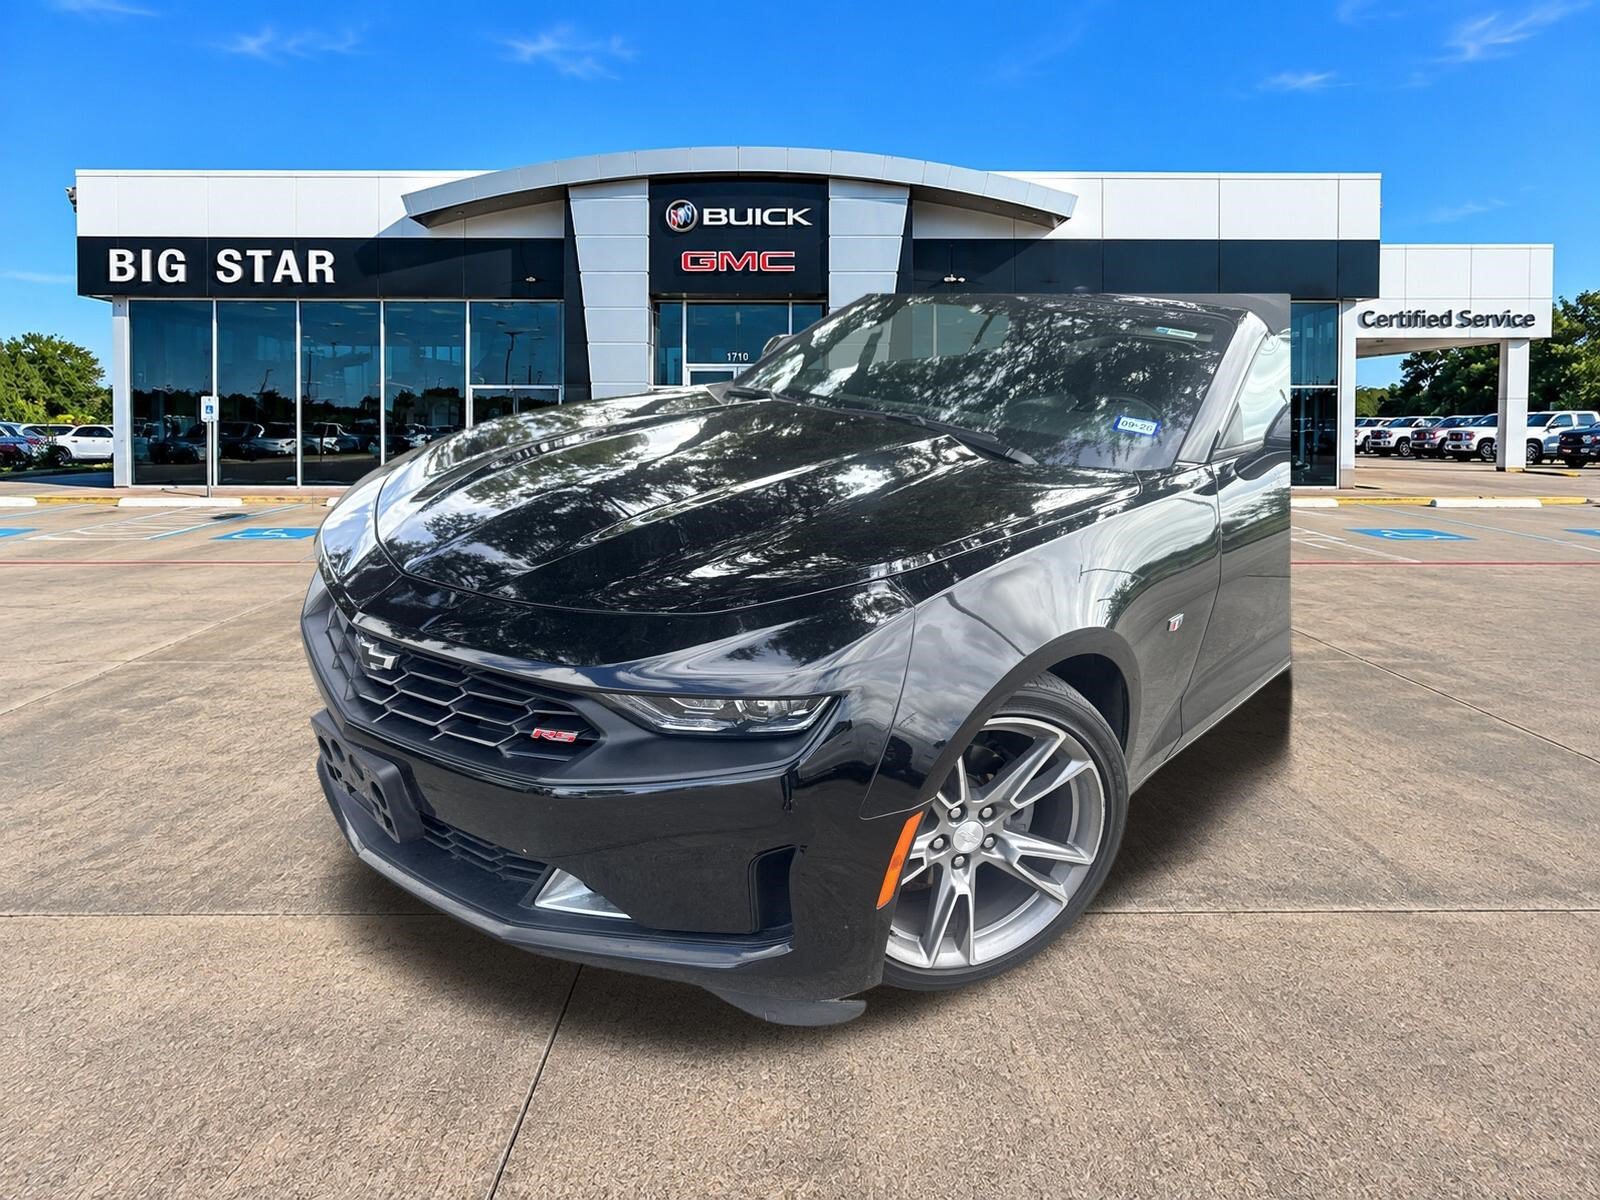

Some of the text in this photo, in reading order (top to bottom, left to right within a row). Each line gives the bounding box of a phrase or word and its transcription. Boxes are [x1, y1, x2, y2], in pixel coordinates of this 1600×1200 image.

[702, 207, 813, 226] BUICK
[108, 248, 336, 283] BIG STAR
[681, 250, 796, 272] GMC
[1359, 309, 1536, 329] Certified Service
[727, 352, 749, 361] 1710
[530, 728, 578, 743] RS
